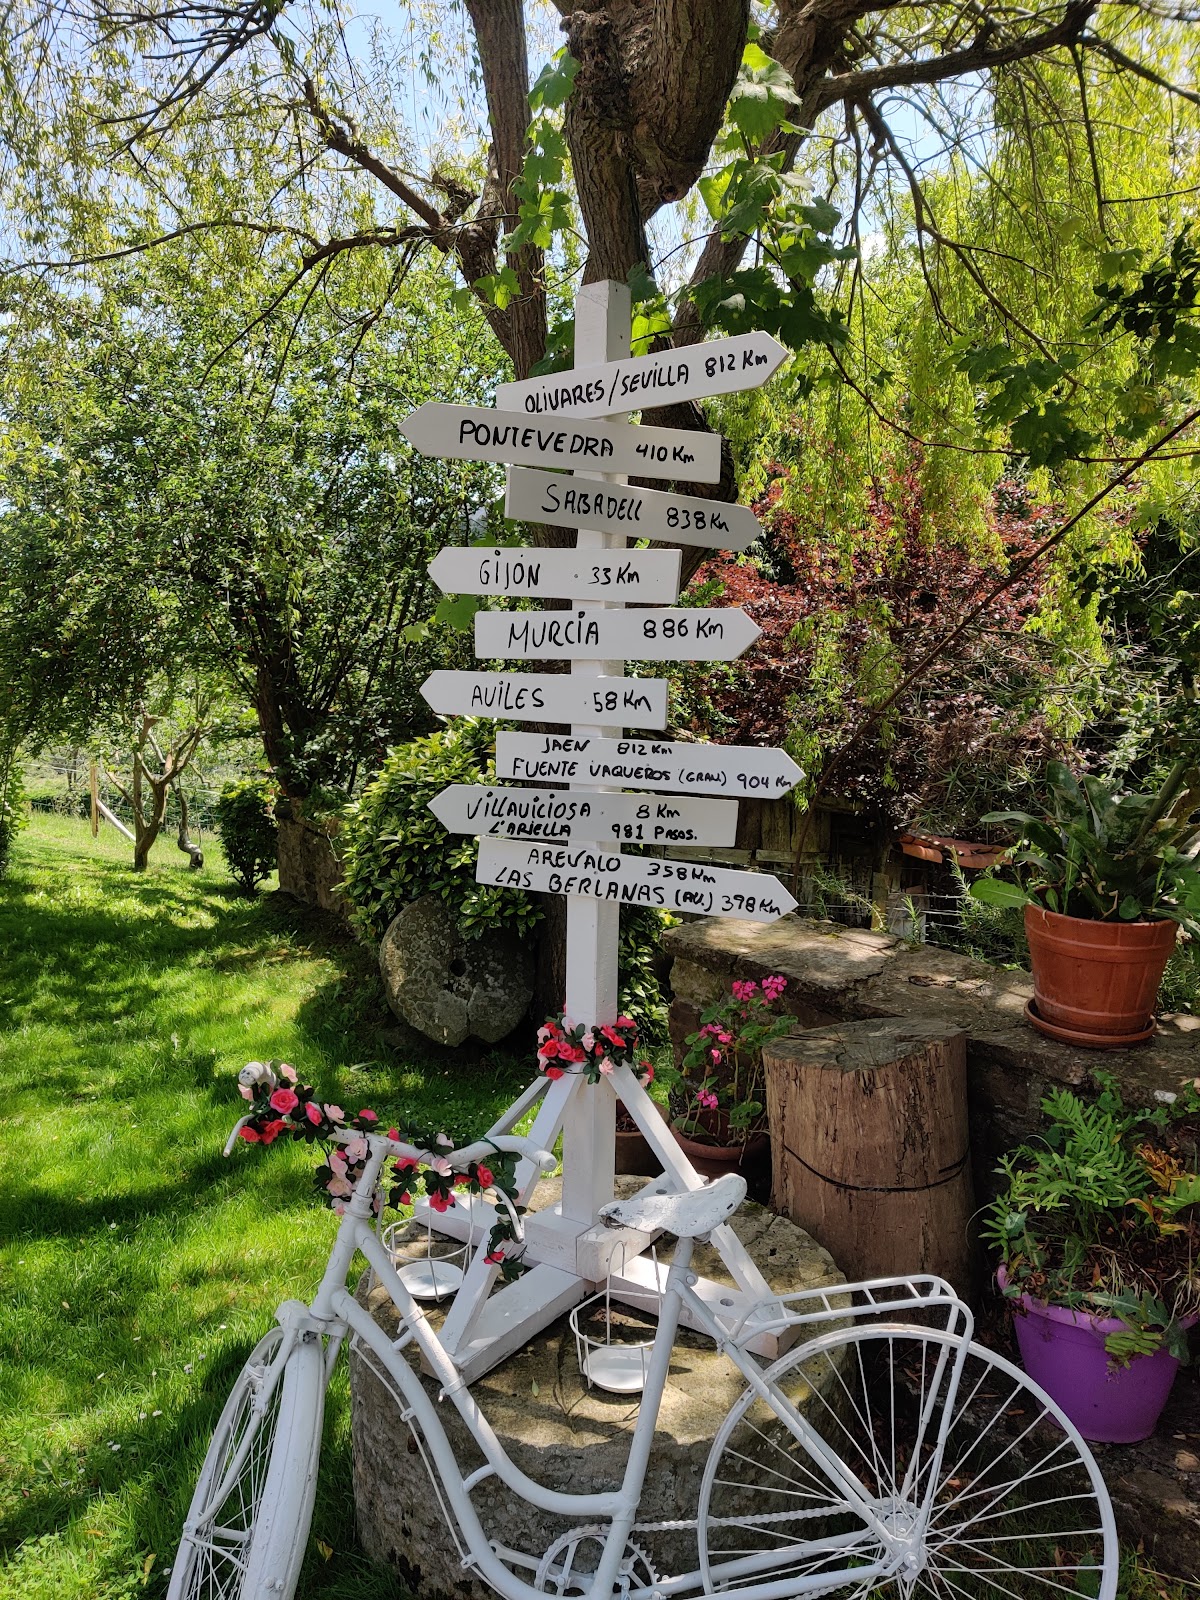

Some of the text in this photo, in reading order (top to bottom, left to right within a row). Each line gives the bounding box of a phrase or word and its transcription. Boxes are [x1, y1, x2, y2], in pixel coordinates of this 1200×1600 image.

[704, 353, 736, 378] 812
[459, 419, 614, 457] PONTEVEDRA
[635, 443, 669, 462] 410
[666, 507, 706, 530] 838
[587, 566, 612, 585] 33
[643, 619, 688, 639] 886
[594, 691, 618, 713] 58
[541, 738, 591, 754] JAEN
[617, 741, 647, 755] 812
[512, 757, 579, 778] FUENTE
[736, 773, 770, 790] 904
[636, 804, 650, 819] 8
[611, 823, 644, 839] 981
[527, 848, 621, 872] AREVALO
[647, 862, 688, 881] 358
[495, 866, 533, 888] LAS
[548, 873, 665, 904] BERLANAS
[721, 894, 756, 913] 398
